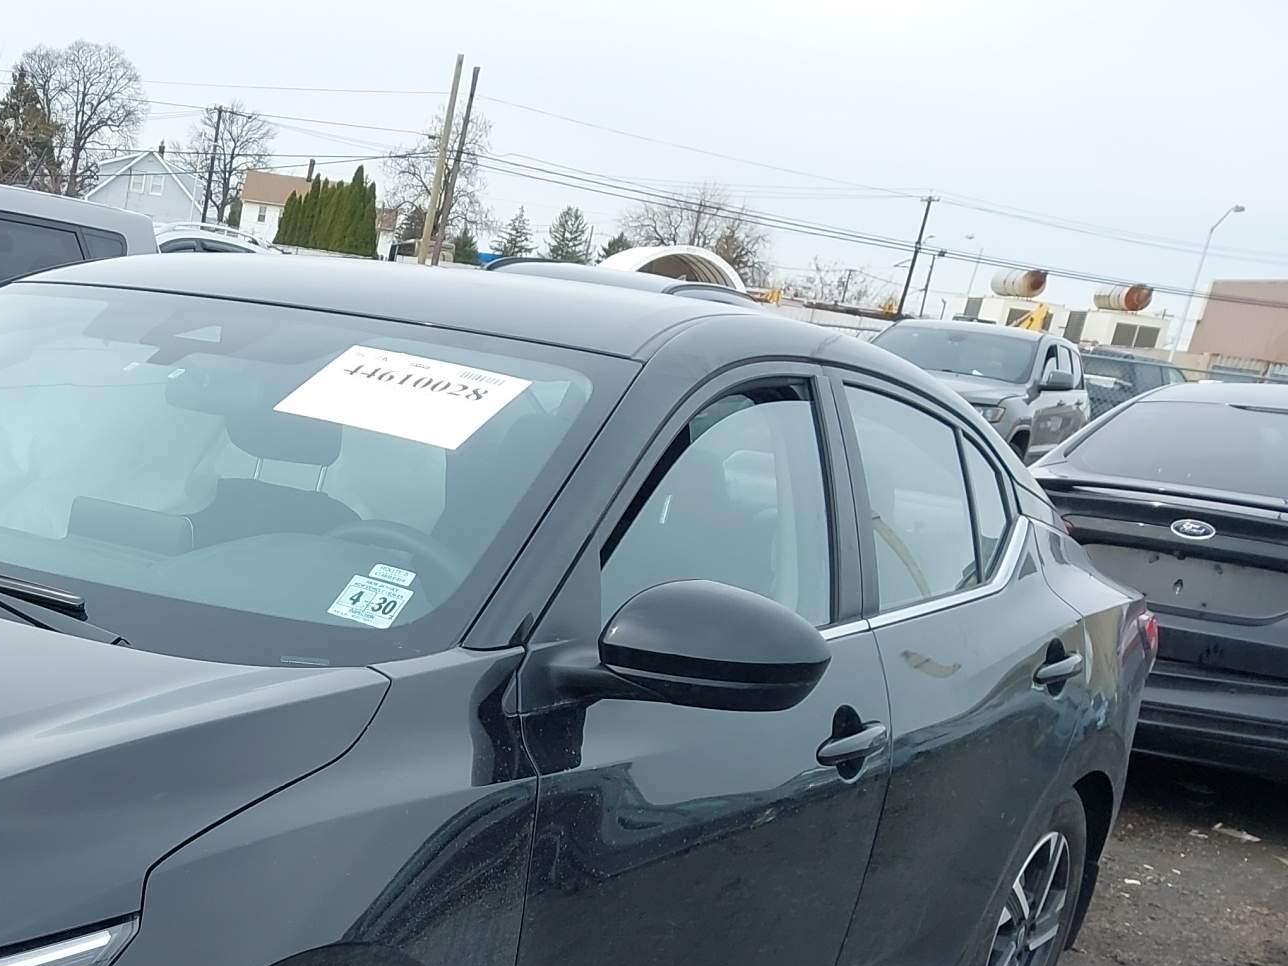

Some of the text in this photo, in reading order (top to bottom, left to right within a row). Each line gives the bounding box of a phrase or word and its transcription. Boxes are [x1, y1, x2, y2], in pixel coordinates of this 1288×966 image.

[343, 364, 489, 401] 44610028
[349, 590, 364, 606] 4
[371, 597, 397, 615] 30
